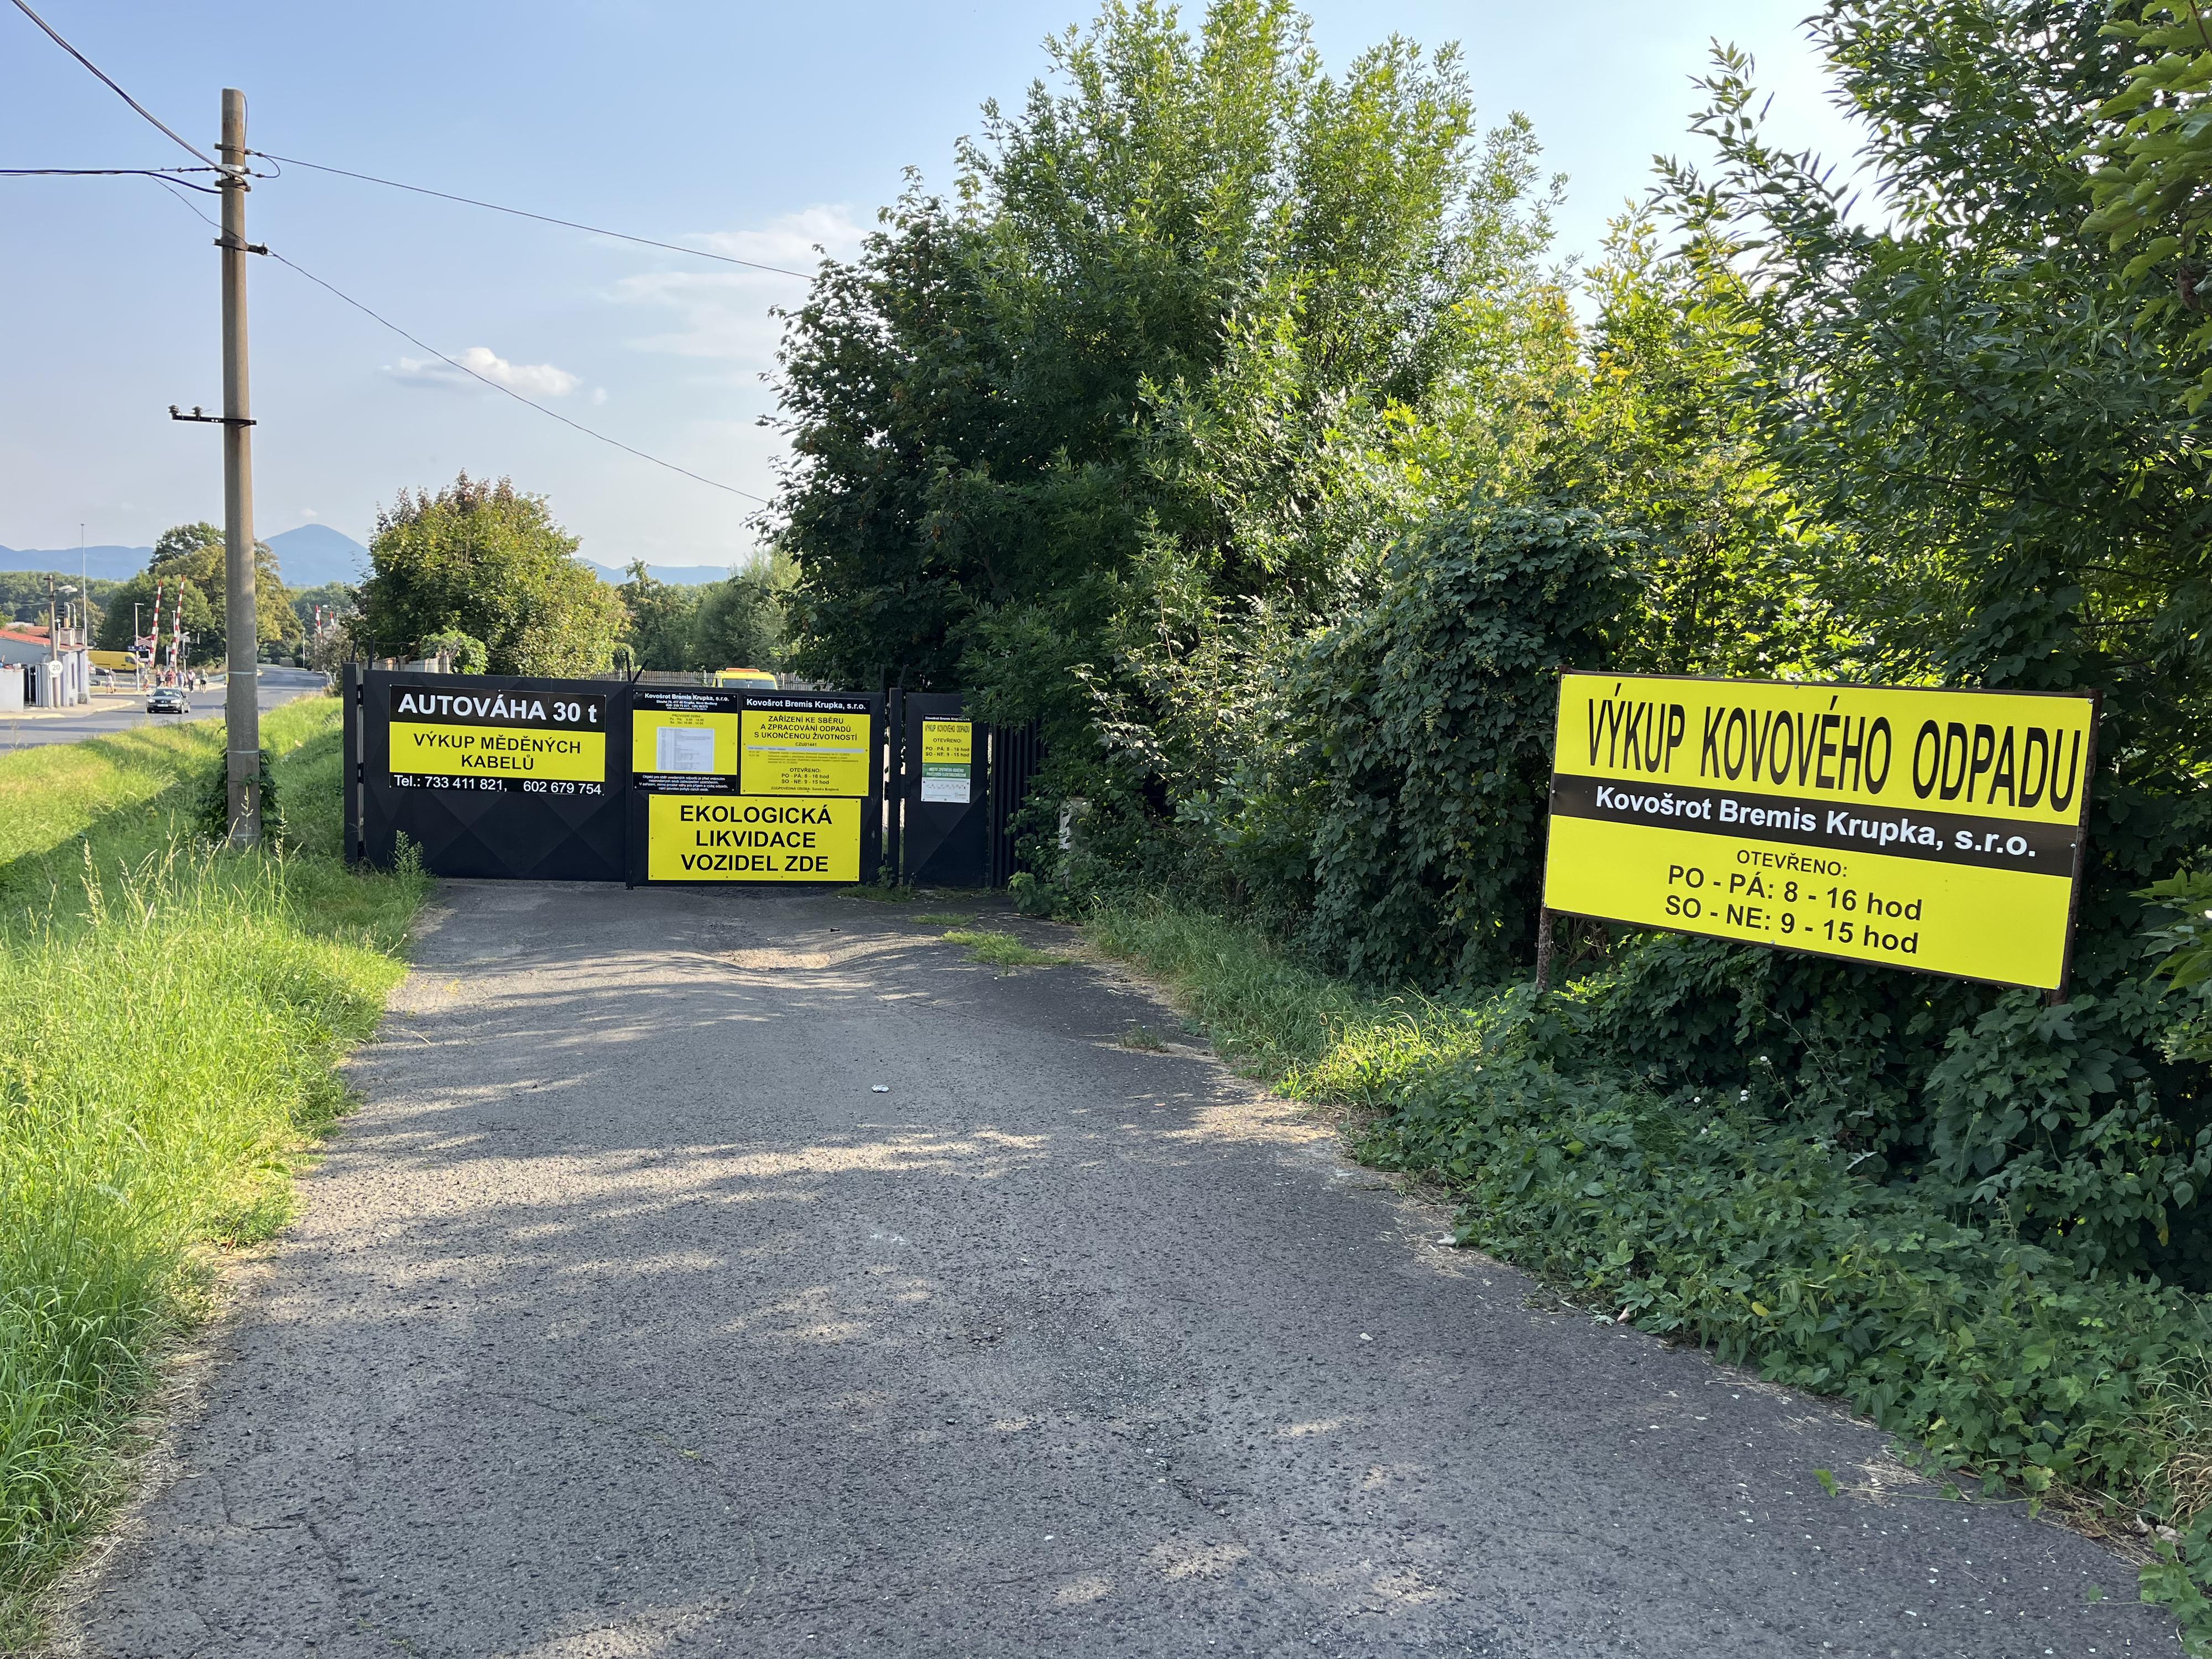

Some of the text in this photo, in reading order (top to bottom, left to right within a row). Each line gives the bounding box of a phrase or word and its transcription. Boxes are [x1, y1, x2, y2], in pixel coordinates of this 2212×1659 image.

[398, 693, 597, 723] AUTOVÁHA 30 t
[815, 701, 845, 710] Krupka,
[413, 732, 581, 754] VÝKUP MĚDĚNÝCH
[1589, 683, 2081, 812] VÝKUP KOVOVÉHO ODPADU
[461, 754, 534, 770] KABELŮ
[394, 775, 420, 786] Tel.:
[425, 776, 449, 787] 733
[453, 778, 474, 789] 411
[479, 779, 507, 792] 821,
[523, 781, 547, 792] 602
[550, 782, 575, 794] 679
[681, 805, 832, 824] EKOLOGICKÁ
[1596, 786, 2036, 857] Kovošrot Bremis Krupka, s.r.o.
[696, 831, 816, 848] LIKVIDACE
[681, 854, 828, 872] VOZIDEL ZDE
[1736, 849, 1848, 878] OTEVŘENO:
[1668, 865, 1705, 889] PO
[1730, 870, 1774, 900] PÁ:
[1783, 881, 1798, 904] 8
[1826, 888, 1856, 911] 16
[1868, 893, 1923, 921] hod
[1665, 894, 1701, 920] SO
[1726, 904, 1771, 931] NE:
[1781, 912, 1795, 935] 9
[1823, 920, 1853, 943] 15
[1864, 924, 1918, 954] hod
